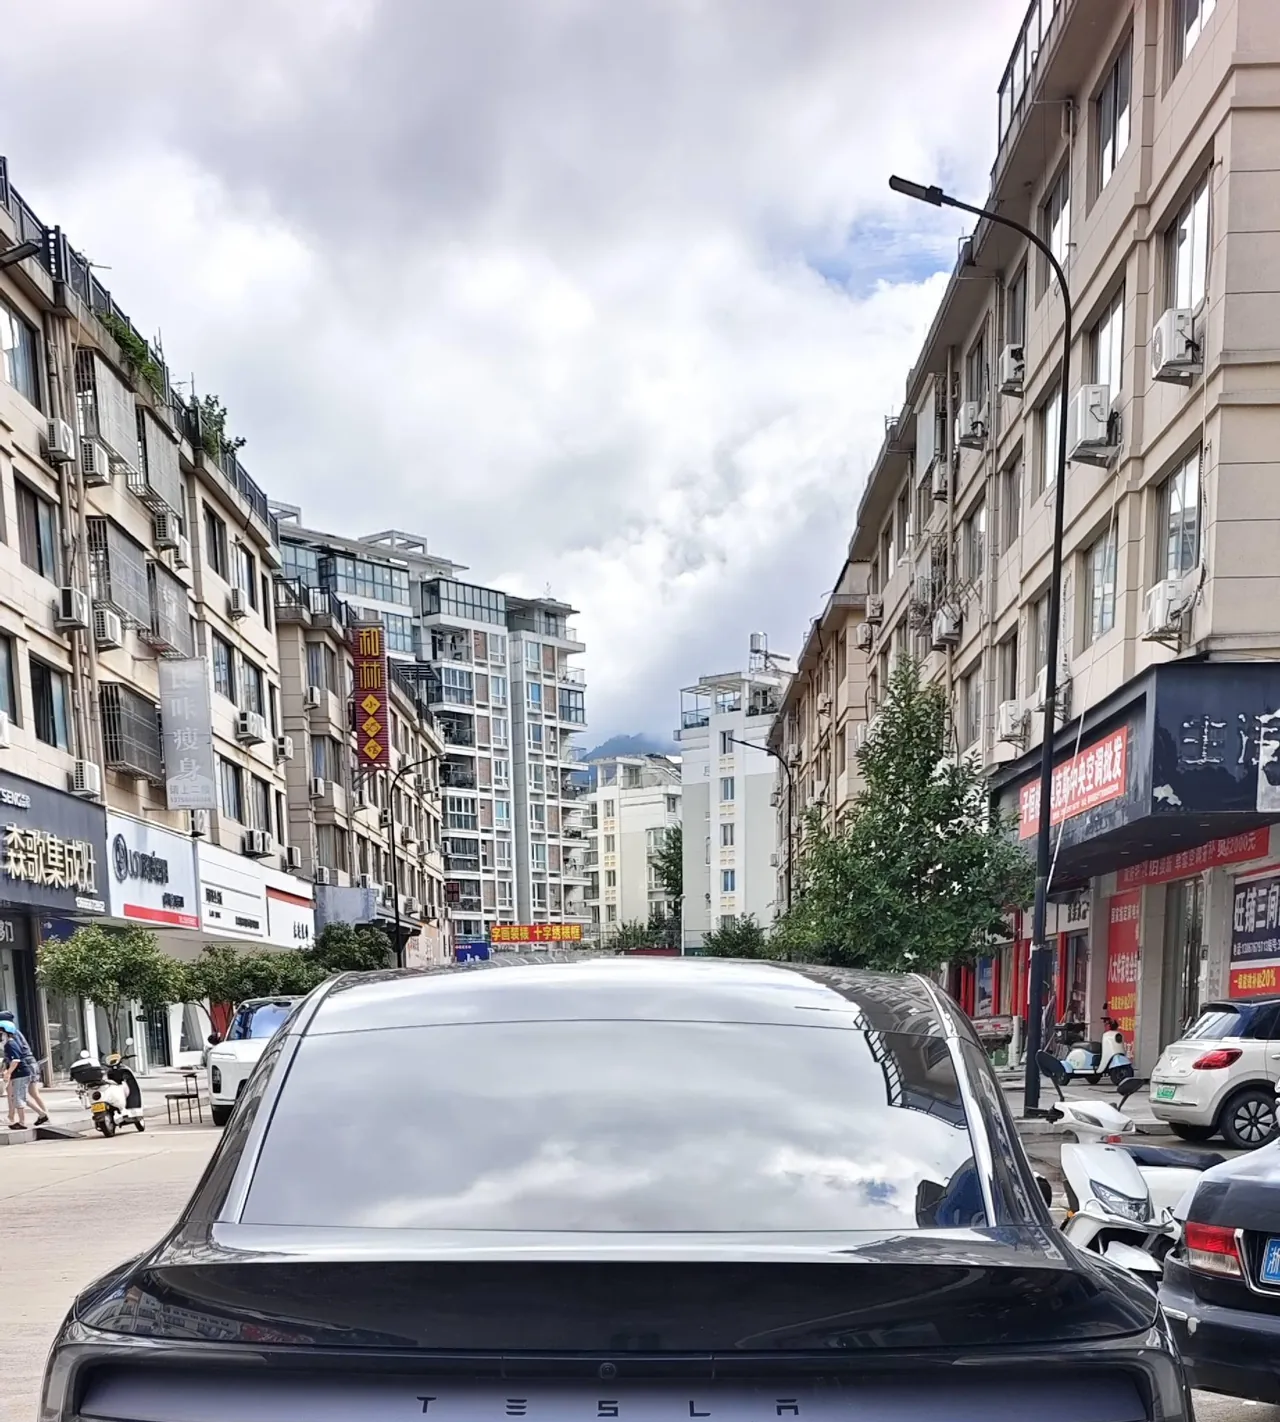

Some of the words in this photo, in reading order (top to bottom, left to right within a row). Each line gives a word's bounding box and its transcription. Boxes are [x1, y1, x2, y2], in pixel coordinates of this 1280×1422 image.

[4, 822, 98, 894] 森歌集成灶
[1233, 883, 1280, 933] 旺铺三间
[416, 1396, 800, 1418] TESLA
